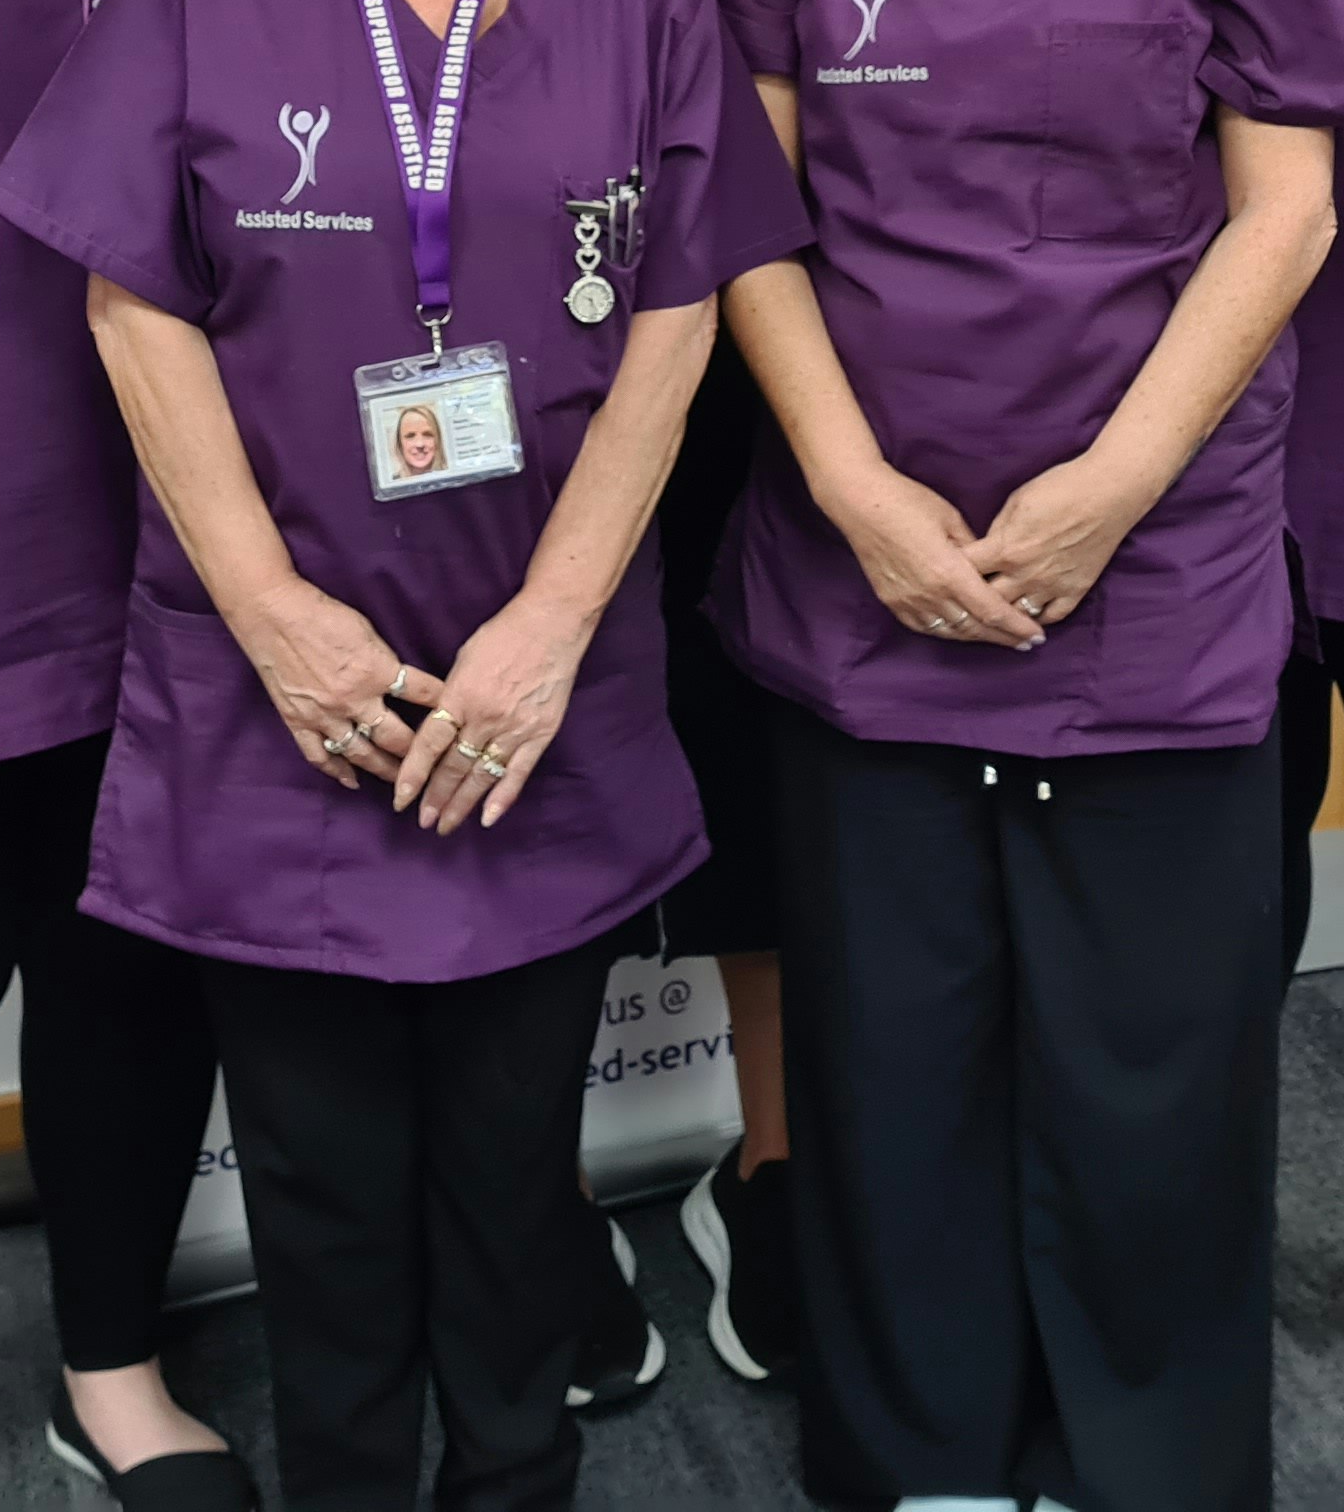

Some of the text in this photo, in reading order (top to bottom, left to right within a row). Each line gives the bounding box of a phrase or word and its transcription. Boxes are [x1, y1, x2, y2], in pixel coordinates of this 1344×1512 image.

[439, 0, 479, 99] SUPERVISOR
[865, 65, 929, 82] Services
[424, 105, 456, 191] ASSISTED
[235, 209, 374, 232] Assisted Services
